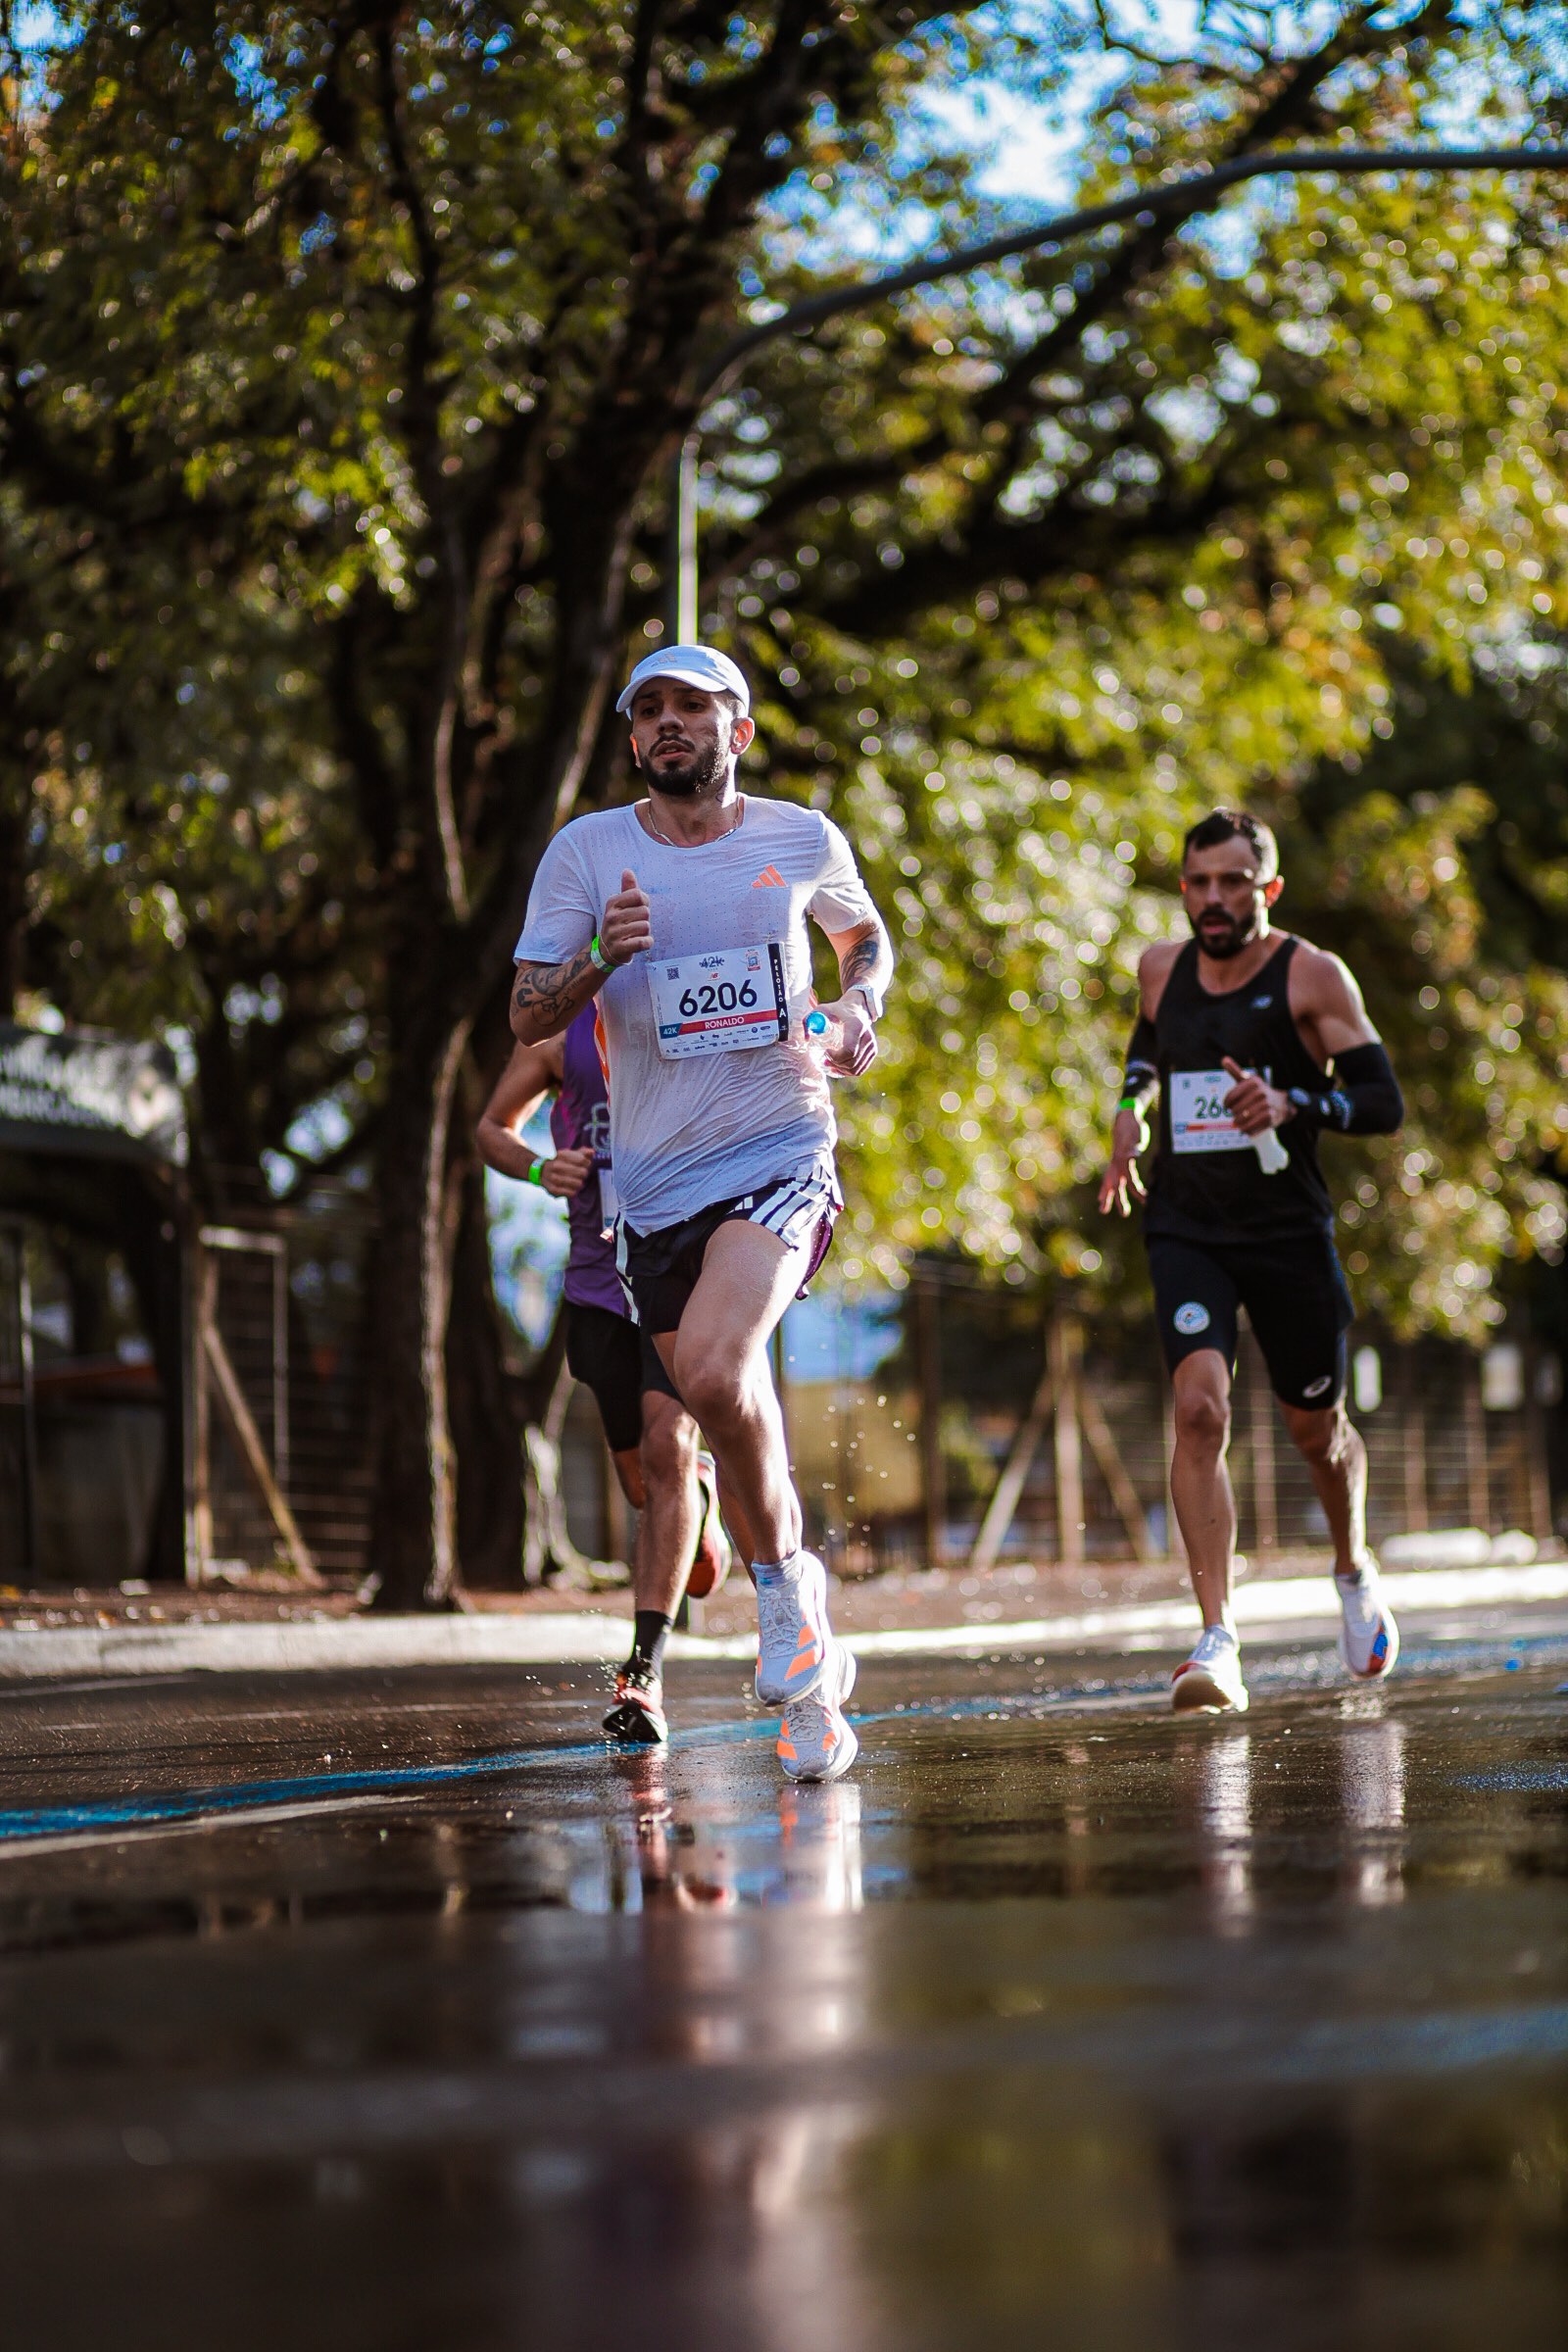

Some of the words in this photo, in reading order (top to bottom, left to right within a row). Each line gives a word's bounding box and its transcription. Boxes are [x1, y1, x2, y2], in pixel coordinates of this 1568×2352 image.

[678, 979, 758, 1017] 6206
[779, 1009, 787, 1018] A
[705, 1016, 745, 1029] RONALDO
[662, 1026, 678, 1036] 42K
